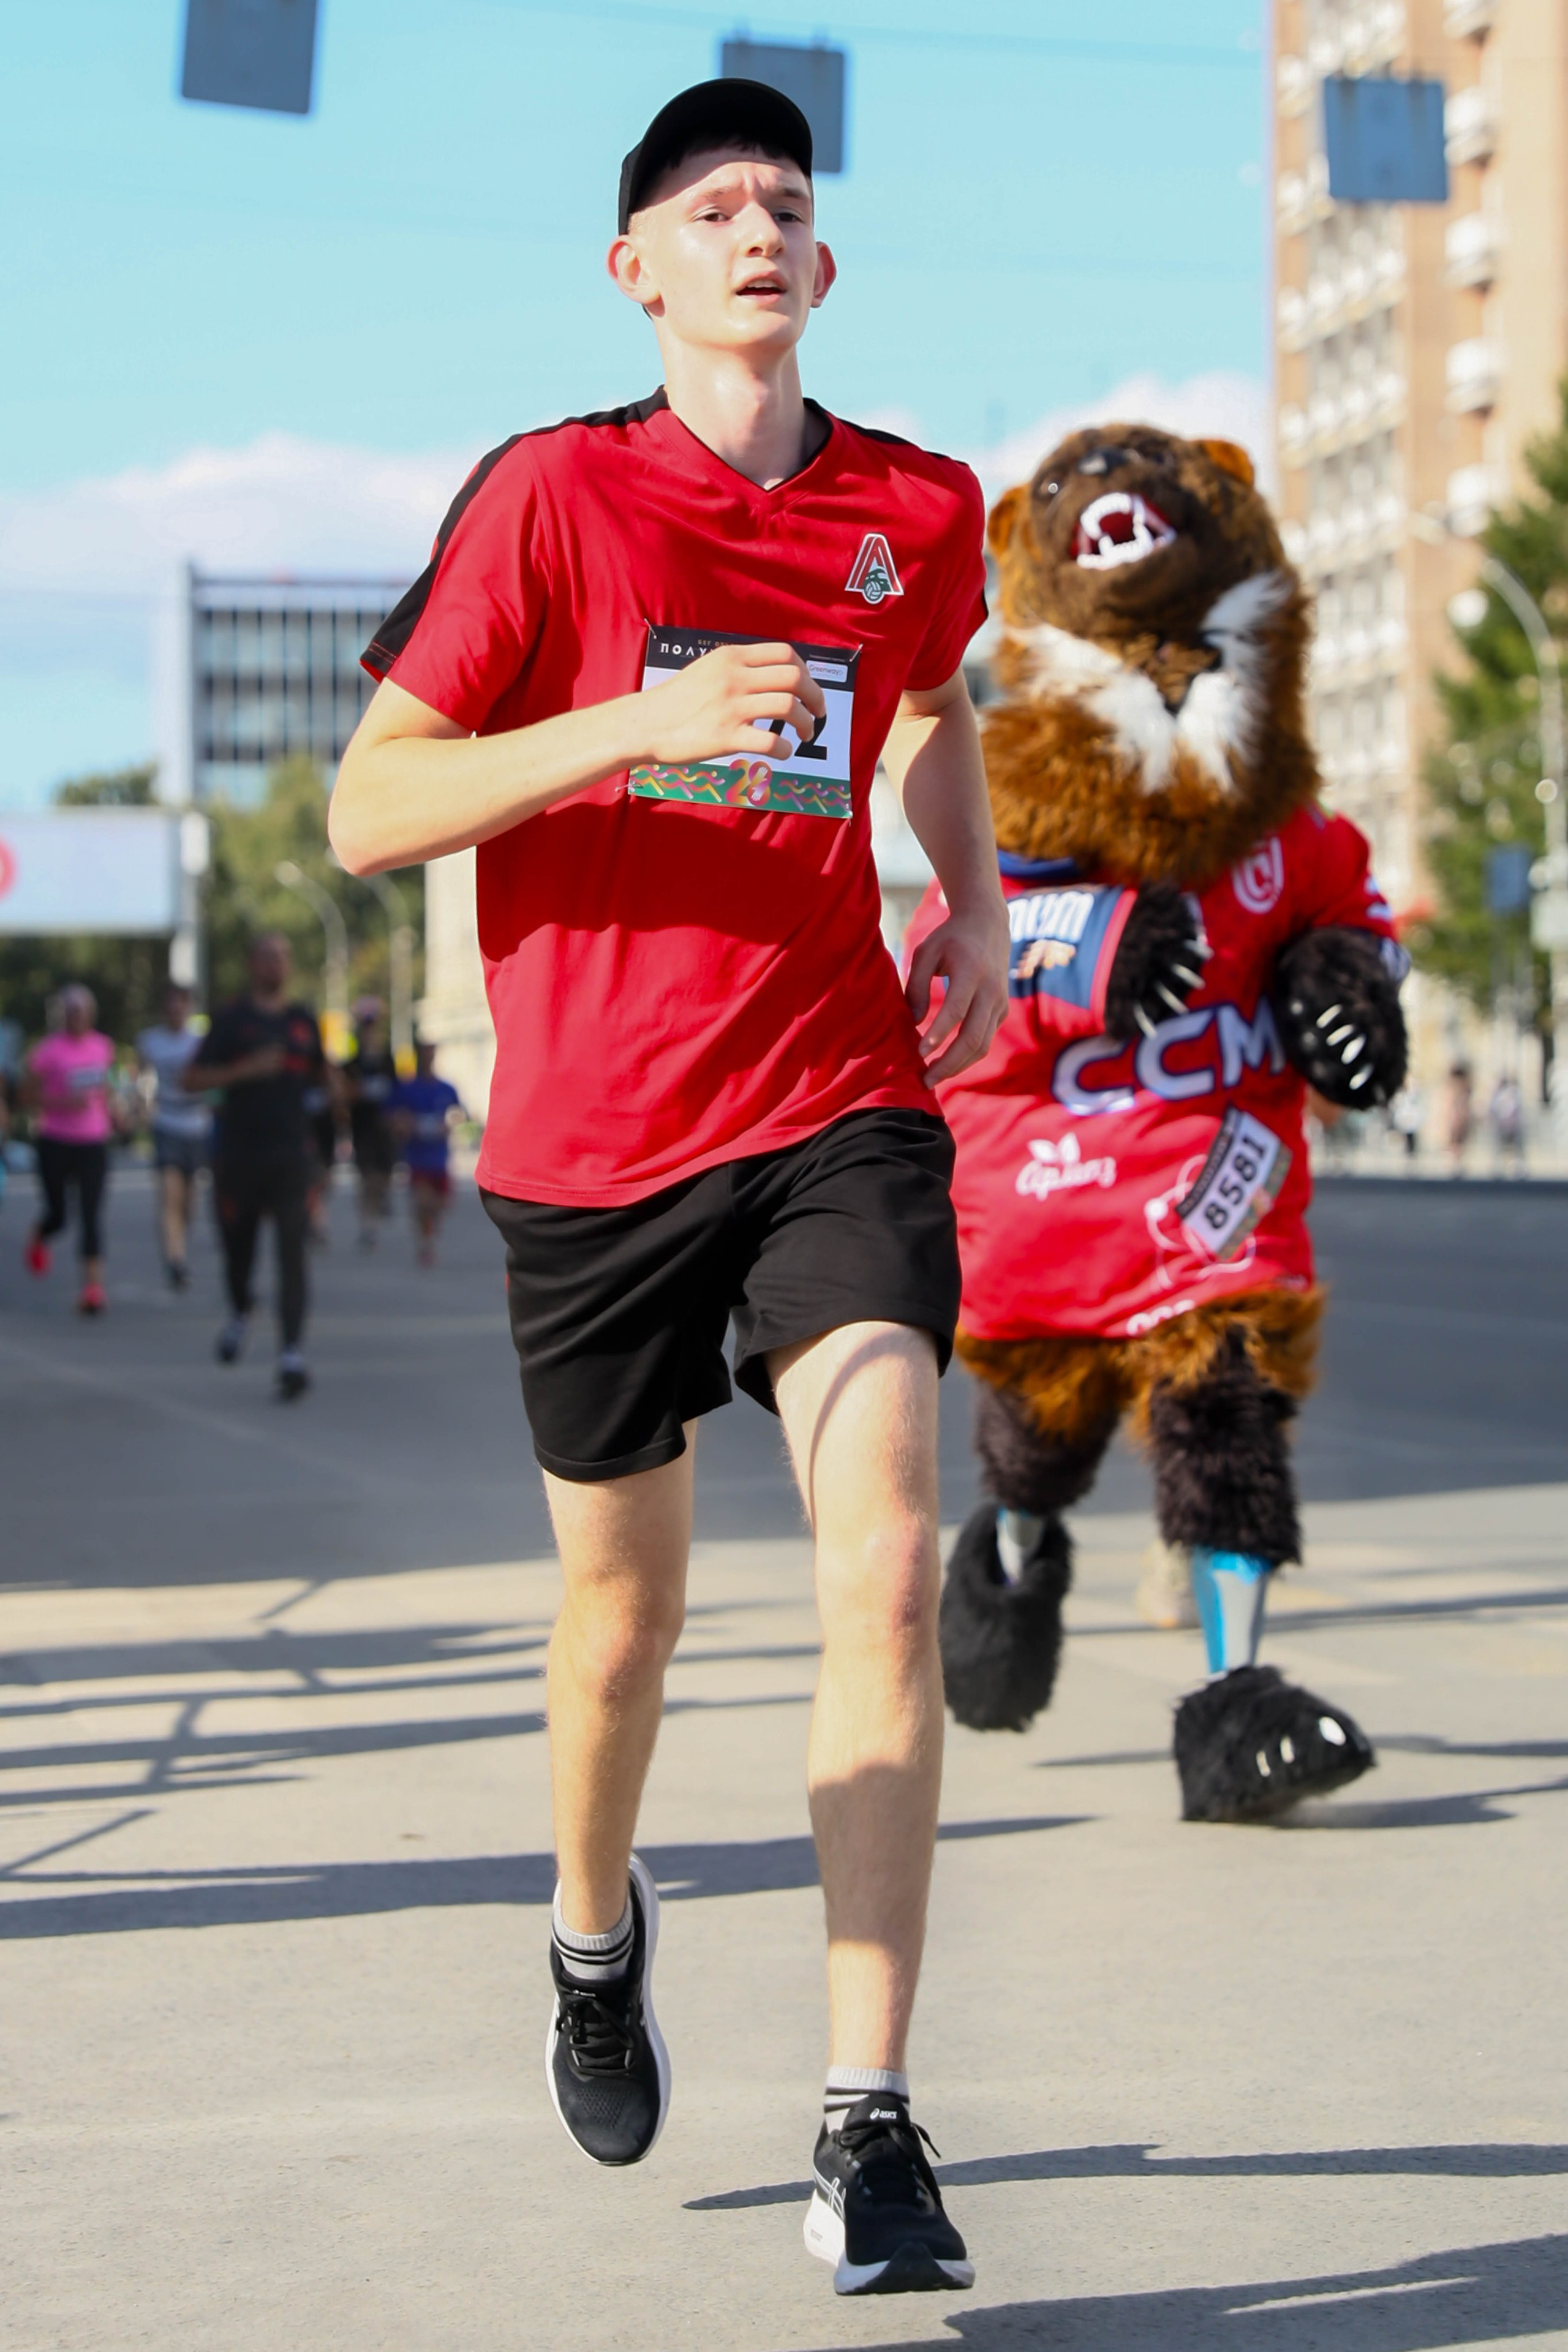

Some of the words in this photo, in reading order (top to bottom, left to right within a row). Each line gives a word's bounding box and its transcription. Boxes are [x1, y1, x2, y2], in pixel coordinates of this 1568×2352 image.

[660, 643, 714, 657] ПОЛУ
[1051, 995, 1286, 1116] CCM
[1204, 1134, 1268, 1229] 8581
